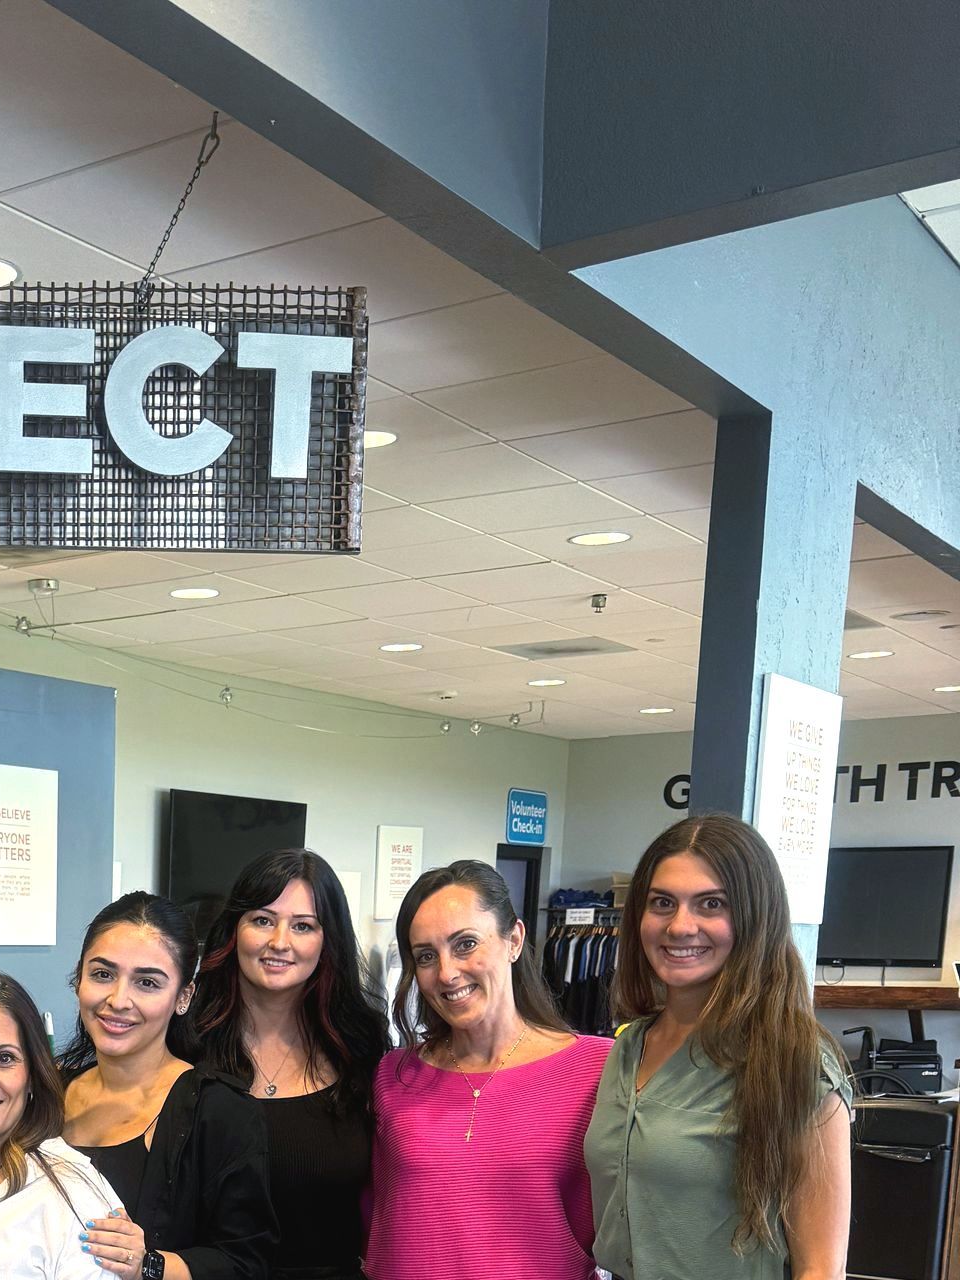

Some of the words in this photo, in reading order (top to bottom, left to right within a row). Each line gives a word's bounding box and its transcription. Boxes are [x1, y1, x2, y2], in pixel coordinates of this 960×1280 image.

[511, 800, 546, 818] Volunteer
[512, 817, 543, 835] Check-in
[391, 844, 401, 853] WE
[402, 844, 413, 853] ARE
